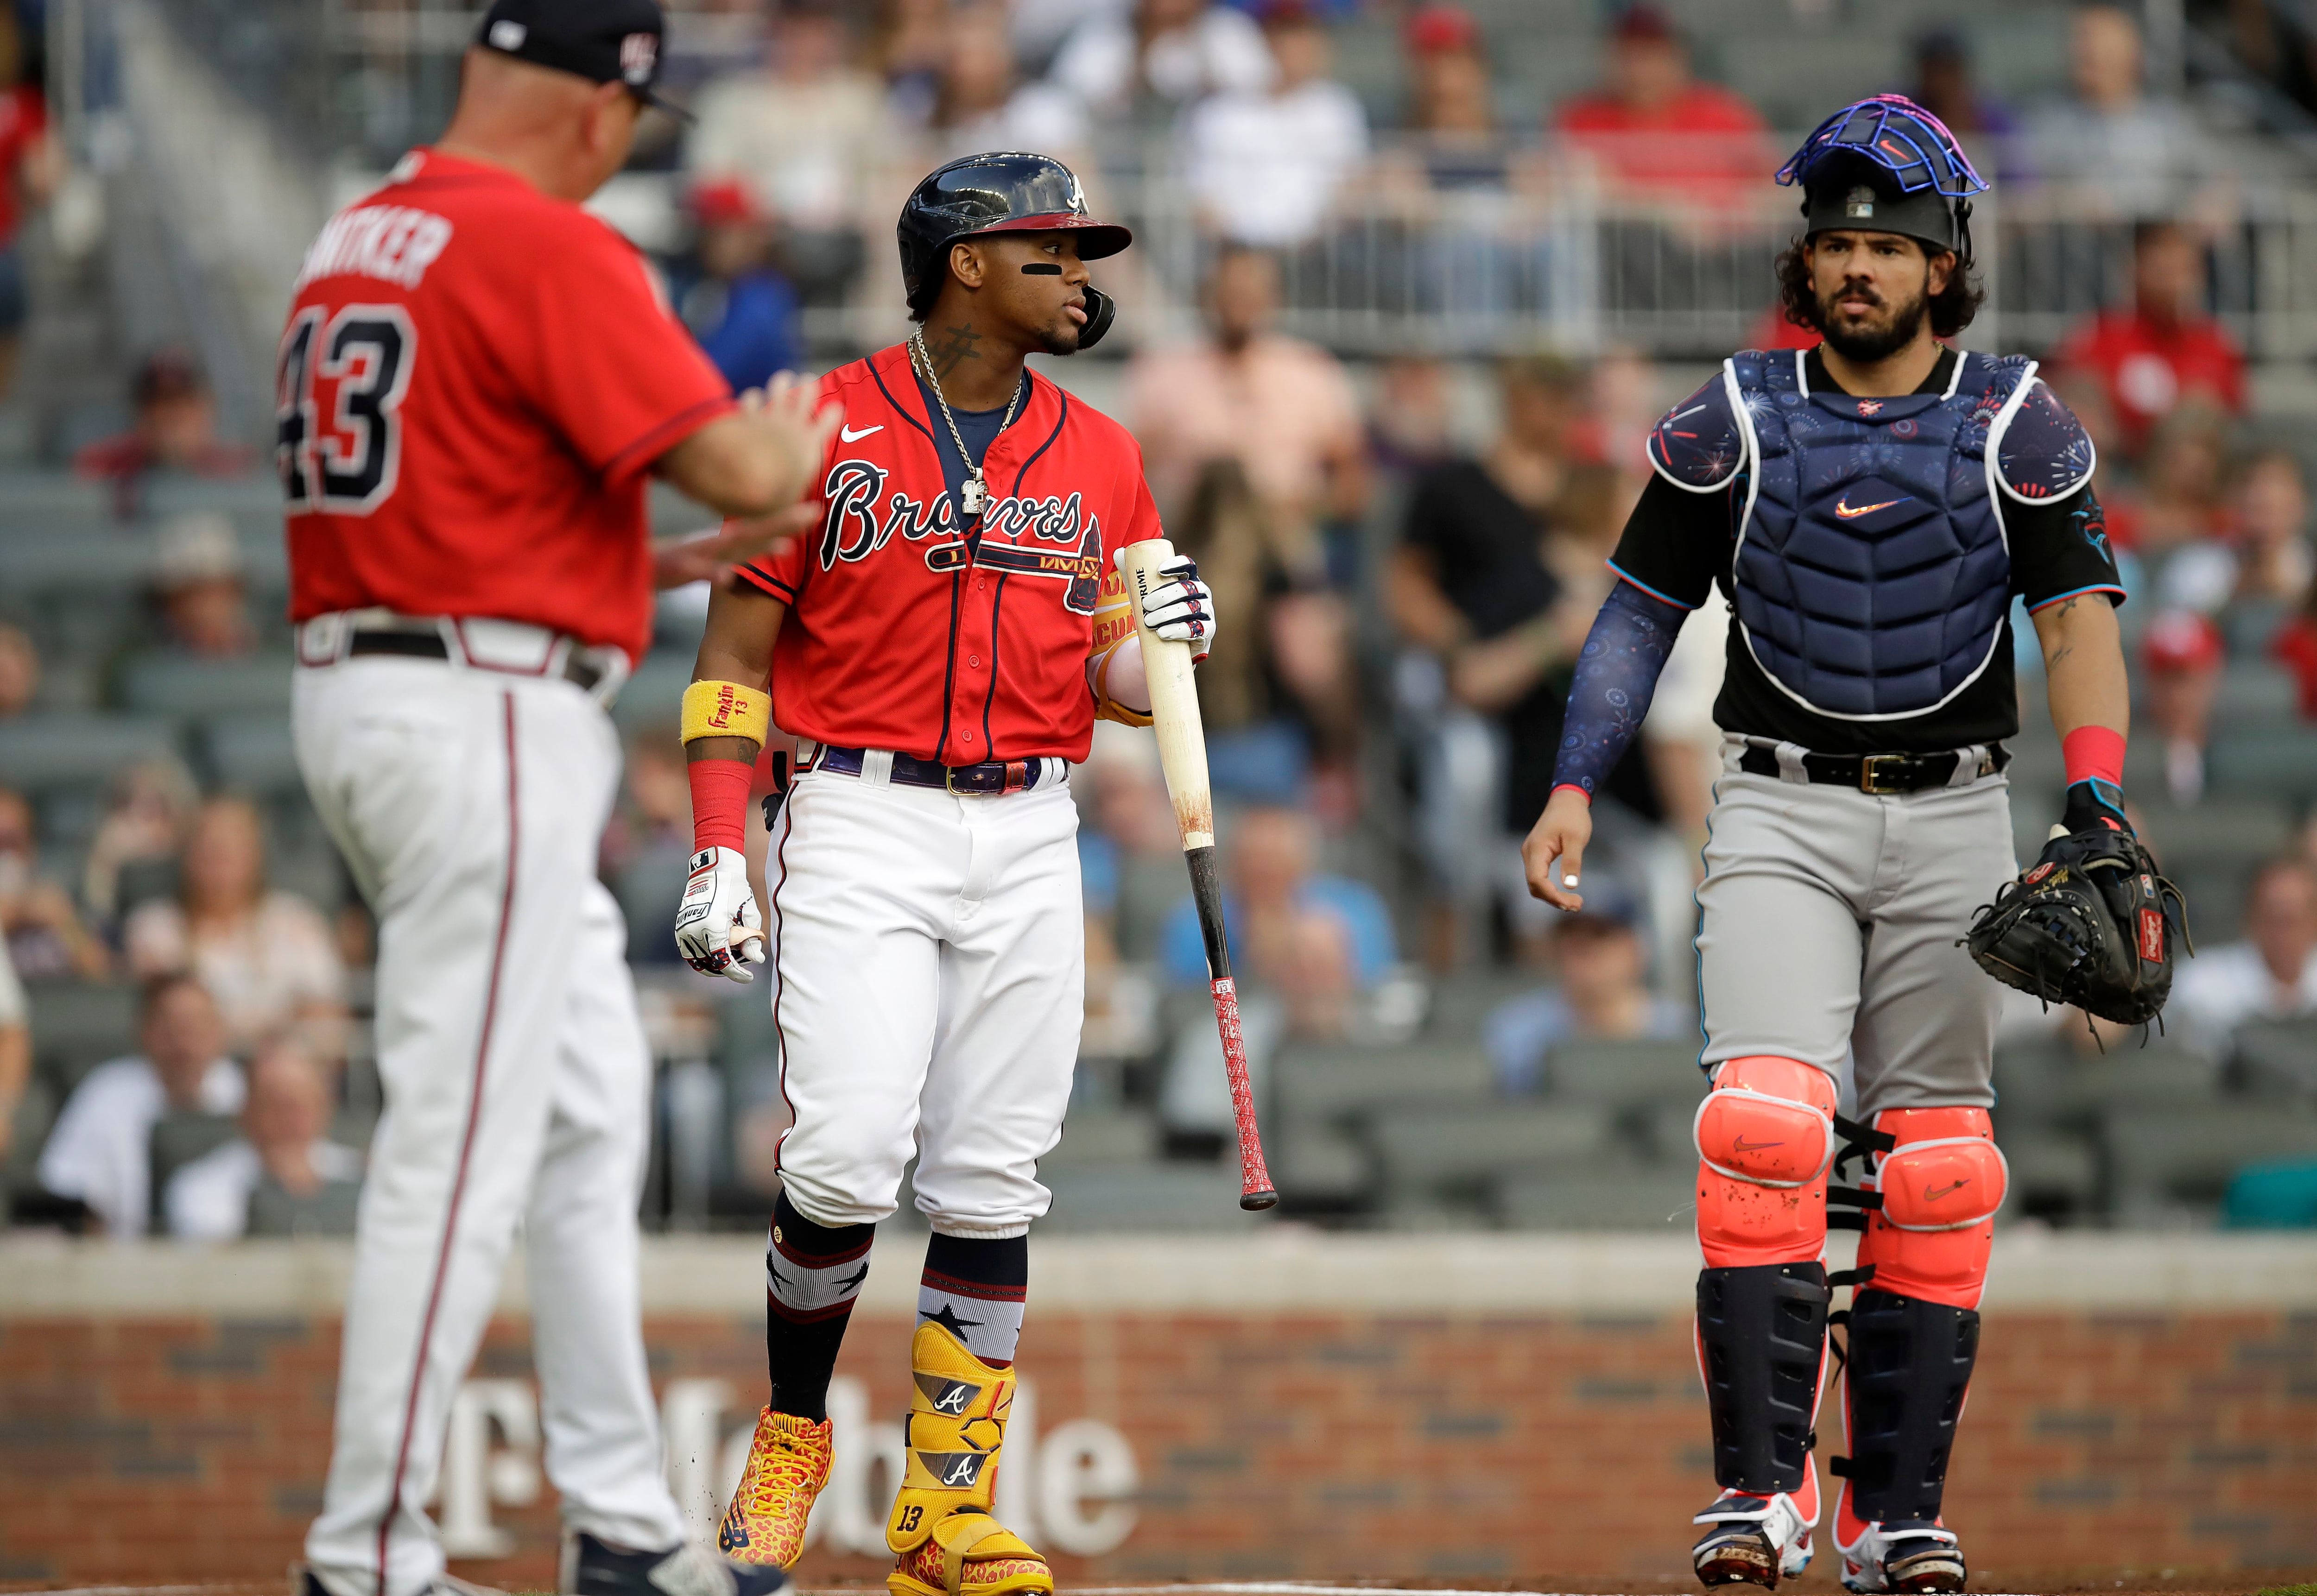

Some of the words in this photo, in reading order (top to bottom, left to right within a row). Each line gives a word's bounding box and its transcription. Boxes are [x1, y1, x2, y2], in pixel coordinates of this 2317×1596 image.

[1066, 174, 1089, 214] A
[276, 303, 418, 517] 43
[819, 459, 1082, 572] Braves
[1135, 567, 1148, 601] RIME
[734, 700, 748, 716] 13
[677, 904, 708, 925] Franklin
[1219, 984, 1228, 993] 13
[934, 1384, 967, 1415] A
[943, 1454, 976, 1486] A
[896, 1505, 924, 1533] 13
